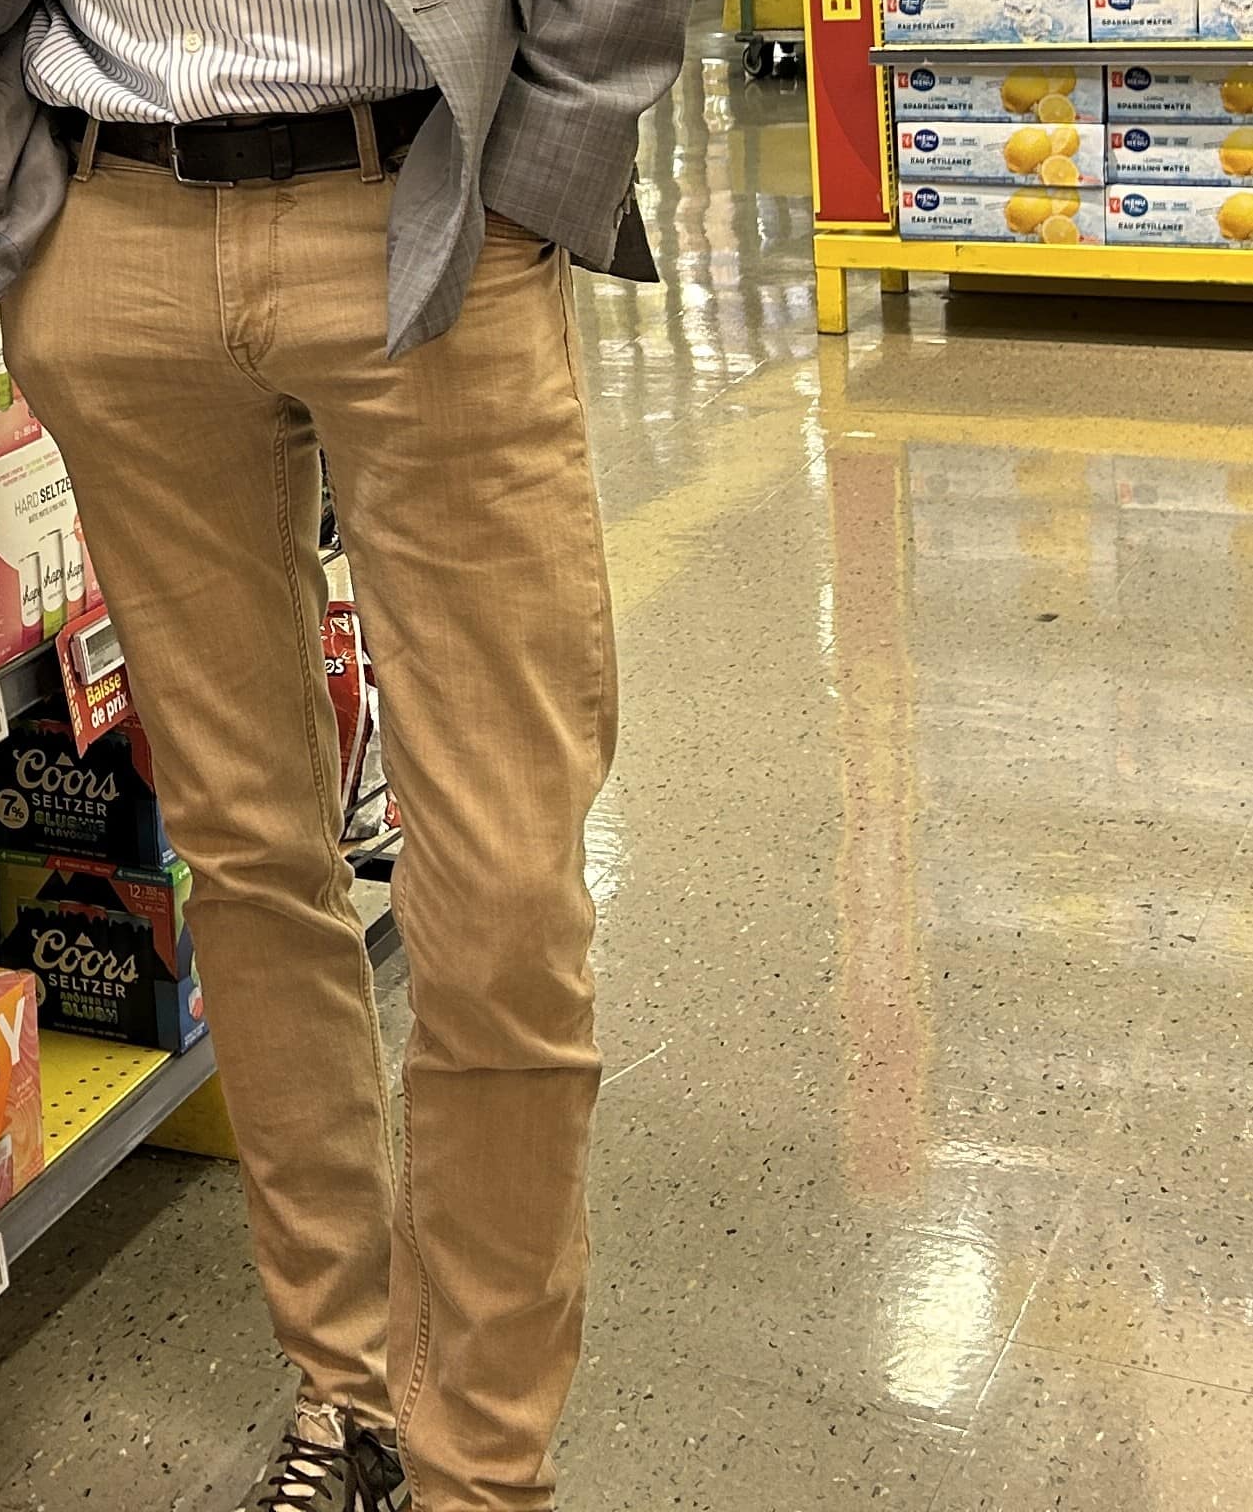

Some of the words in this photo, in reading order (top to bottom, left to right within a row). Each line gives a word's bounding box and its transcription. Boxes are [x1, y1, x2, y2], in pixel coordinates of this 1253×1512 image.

[14, 493, 39, 517] HARD
[39, 477, 72, 504] SELTZE
[85, 671, 122, 707] Baisse
[89, 707, 106, 730] de
[105, 688, 129, 726] prix
[12, 748, 120, 801] Coors
[0, 794, 25, 818] 7%
[31, 792, 108, 817] SELTZER
[31, 928, 139, 984] Coors
[48, 973, 126, 999] SELTZER
